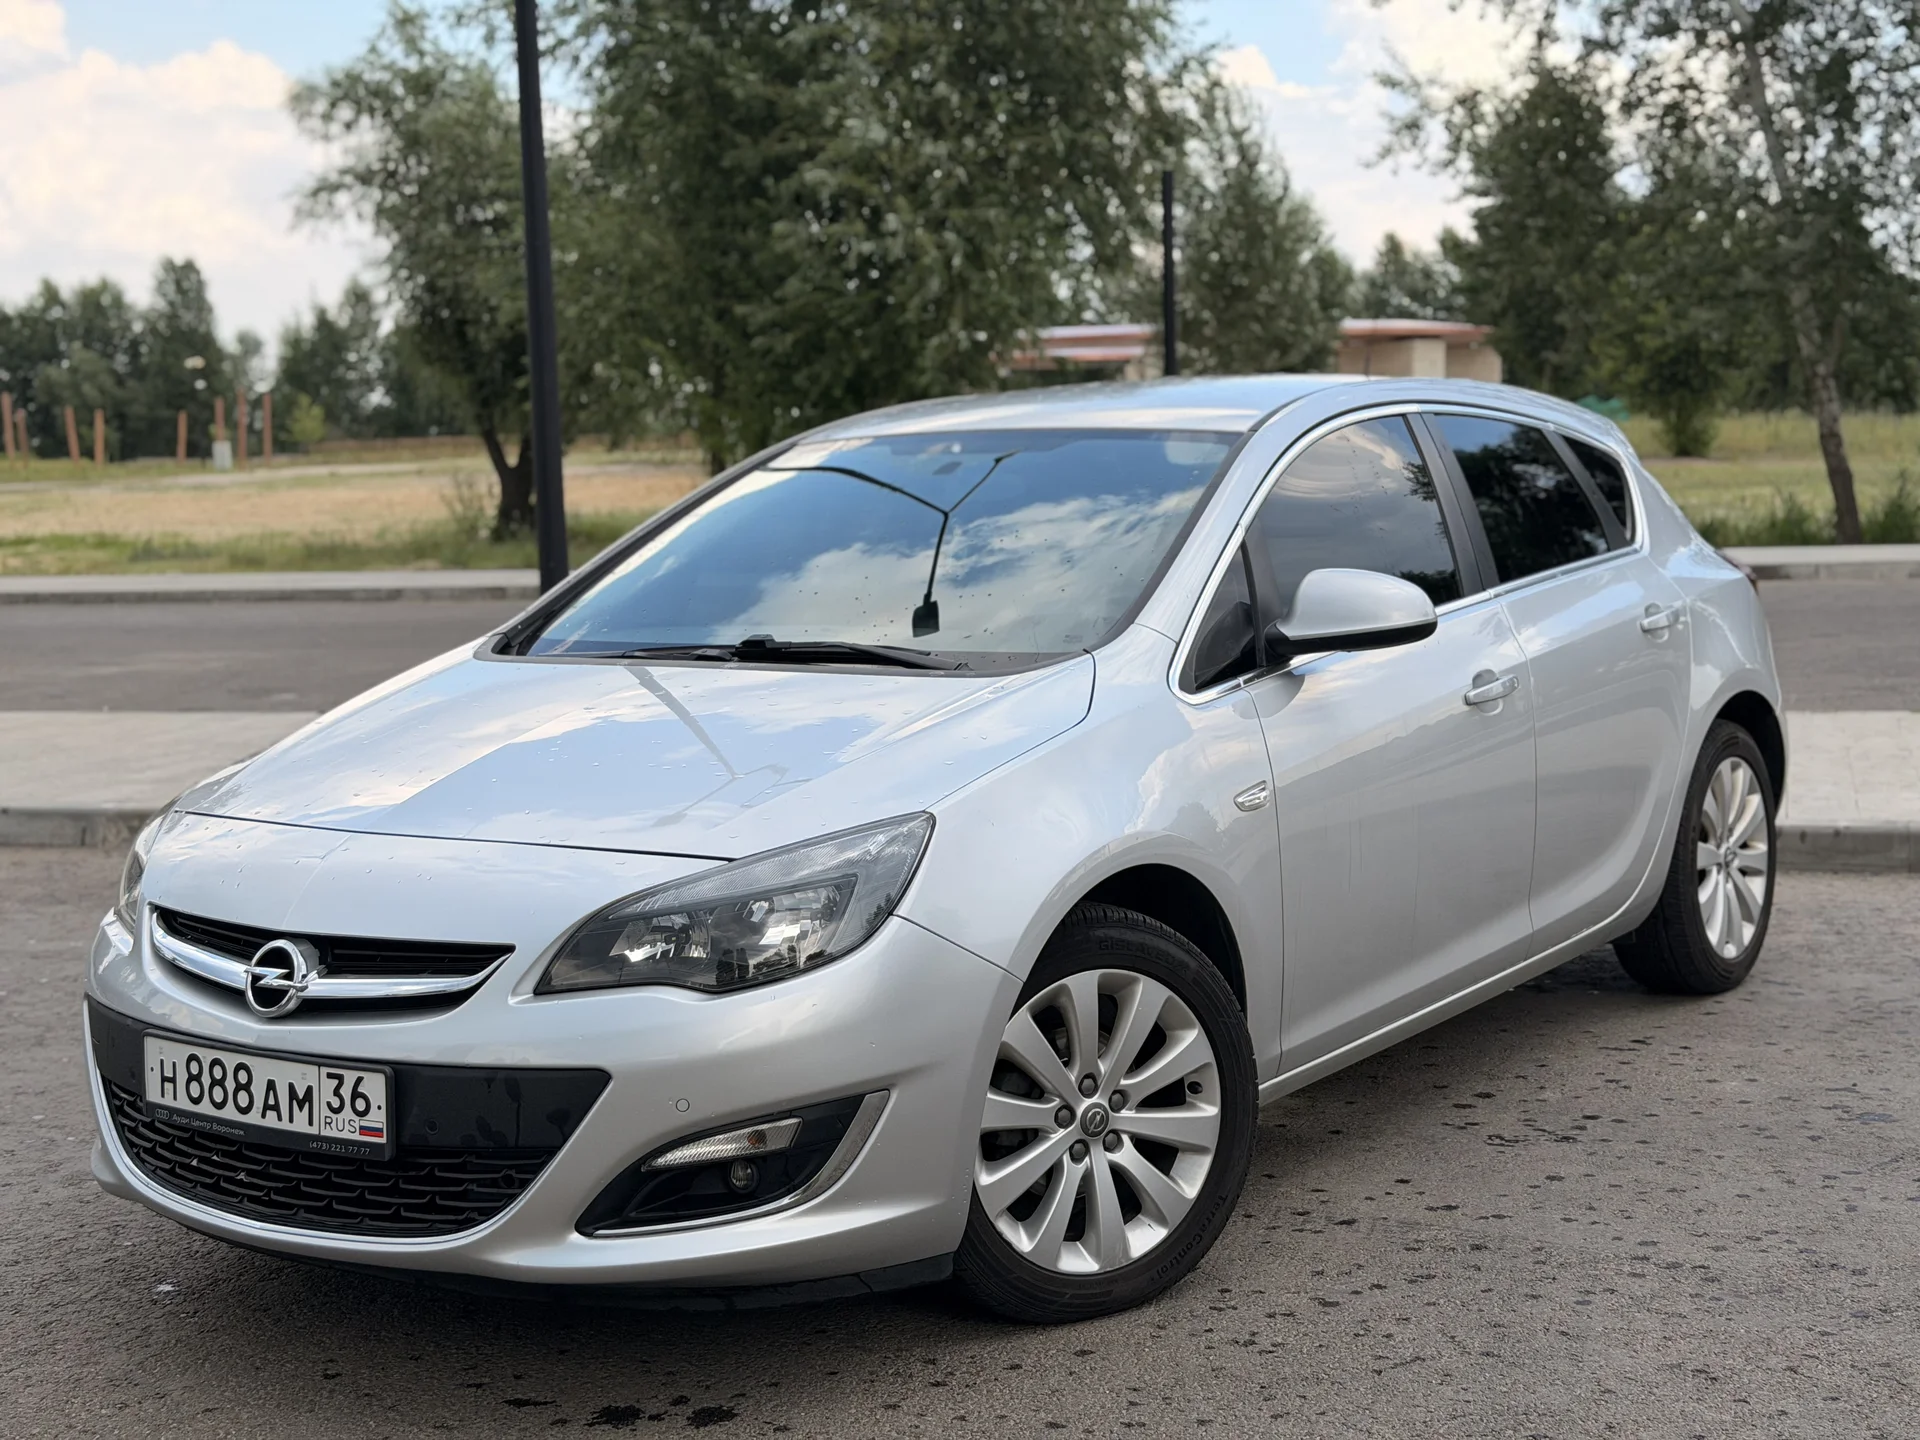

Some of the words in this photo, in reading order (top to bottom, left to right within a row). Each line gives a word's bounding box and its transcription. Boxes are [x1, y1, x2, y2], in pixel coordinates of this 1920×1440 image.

[325, 1071, 372, 1118] 36
[172, 1113, 190, 1125] Ауди
[190, 1117, 212, 1130] Центр
[212, 1122, 245, 1137] Воронеж
[324, 1115, 358, 1134] RUS
[309, 1140, 330, 1151] (473)
[330, 1143, 346, 1153] 221
